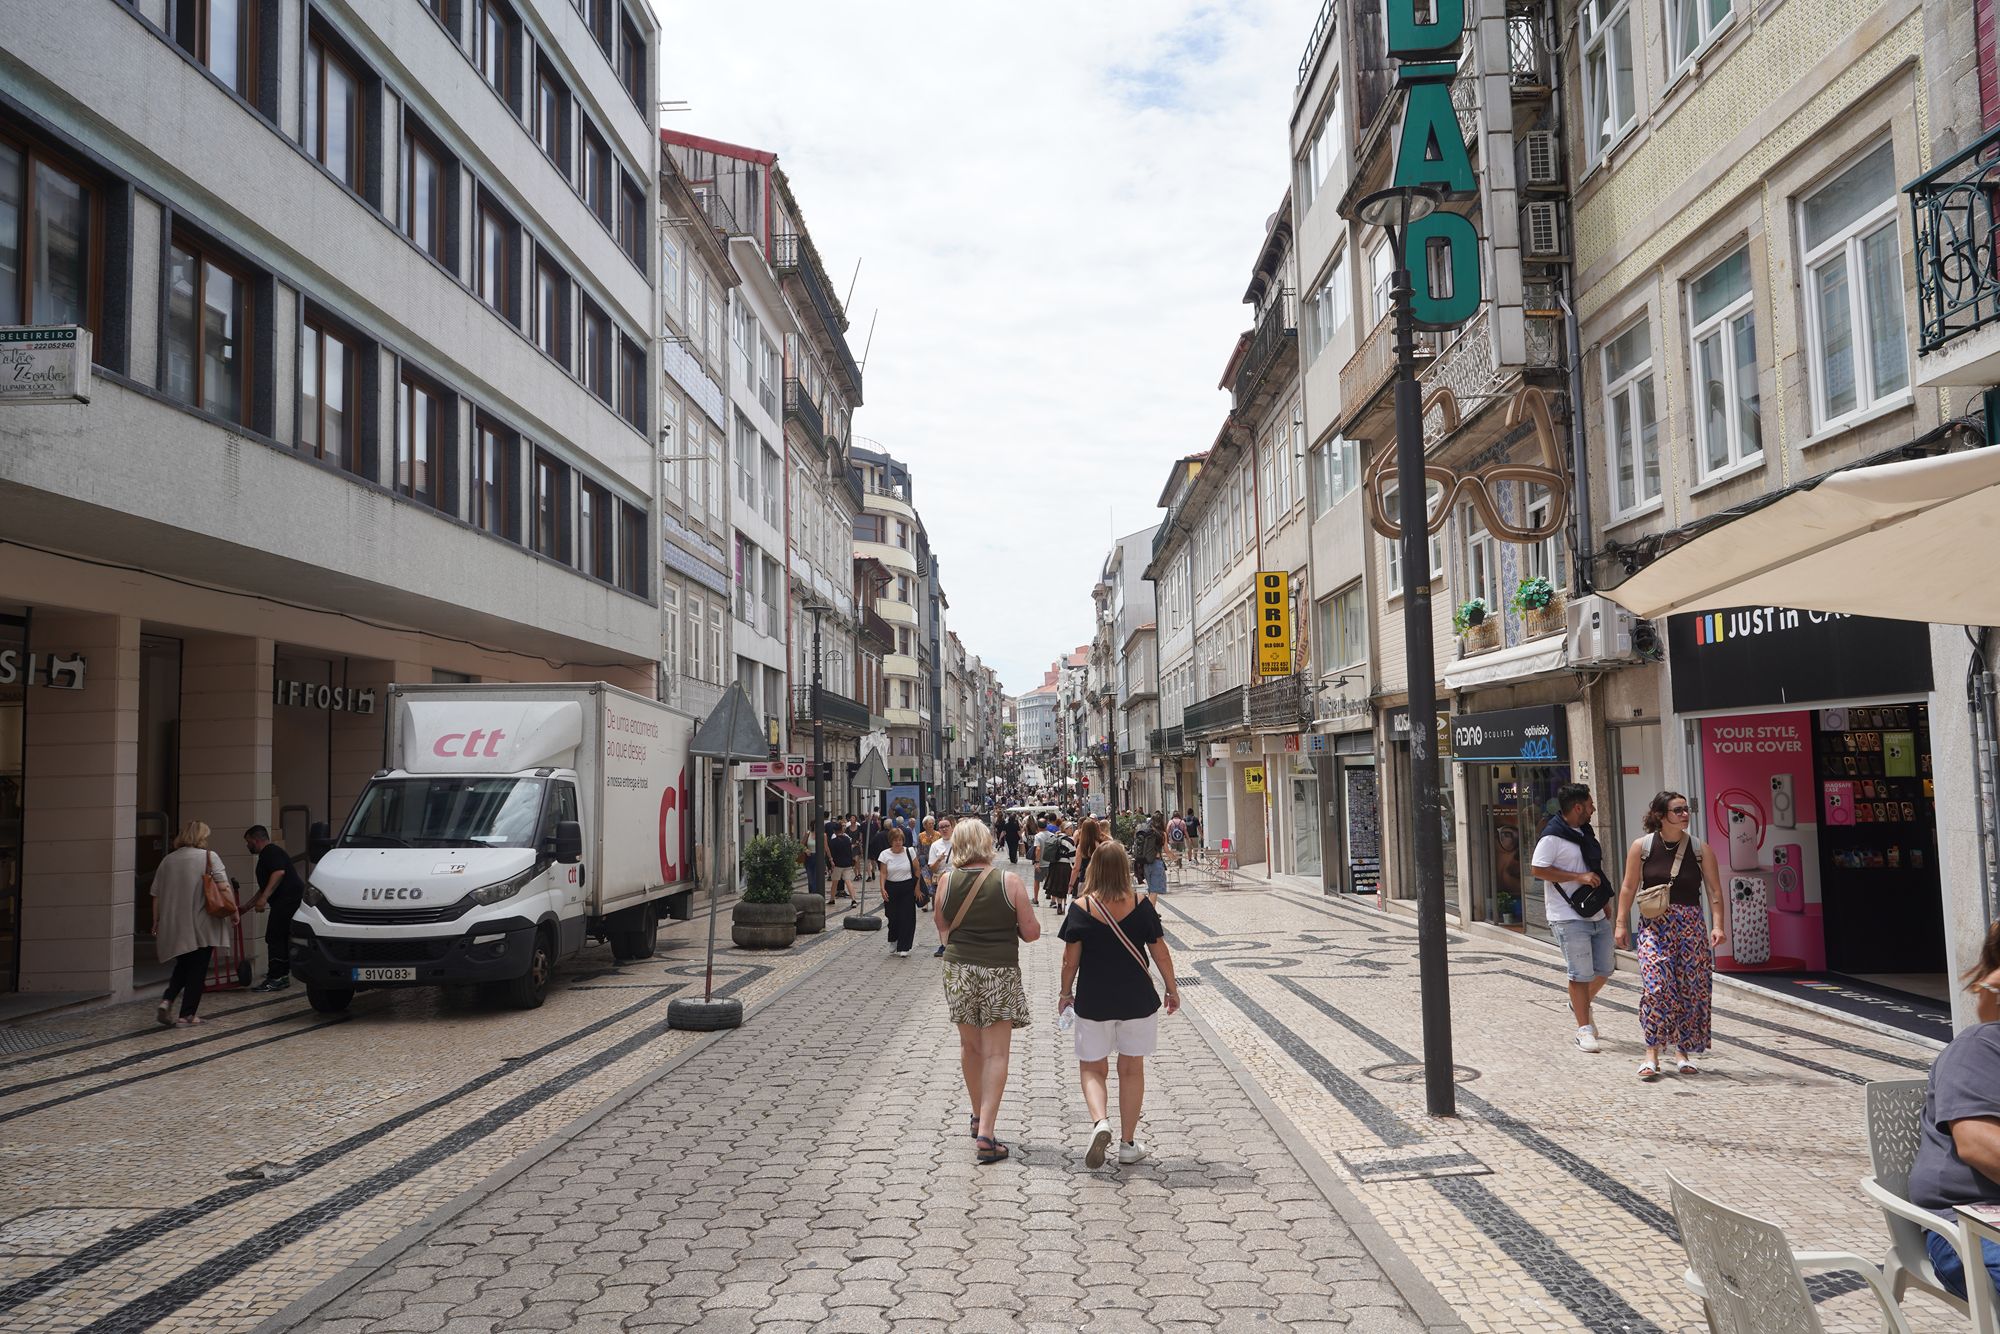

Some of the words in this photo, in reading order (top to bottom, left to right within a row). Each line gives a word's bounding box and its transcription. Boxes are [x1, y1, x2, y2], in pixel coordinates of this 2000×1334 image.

[1264, 575, 1281, 638] OURO
[1728, 607, 1774, 638] JUST
[1779, 607, 1799, 630] in
[277, 680, 352, 711] IFFOSI
[1484, 730, 1515, 738] OCULISTA
[1524, 724, 1549, 738] optivisão
[1713, 727, 1754, 738] YOUR
[1757, 726, 1798, 739] STYLE,
[433, 728, 506, 757] ctt
[1712, 742, 1753, 753] YOUR
[1756, 741, 1802, 752] COVER
[568, 866, 577, 884] ctt
[362, 888, 423, 900] IVECO
[1828, 991, 1893, 1005] JUST
